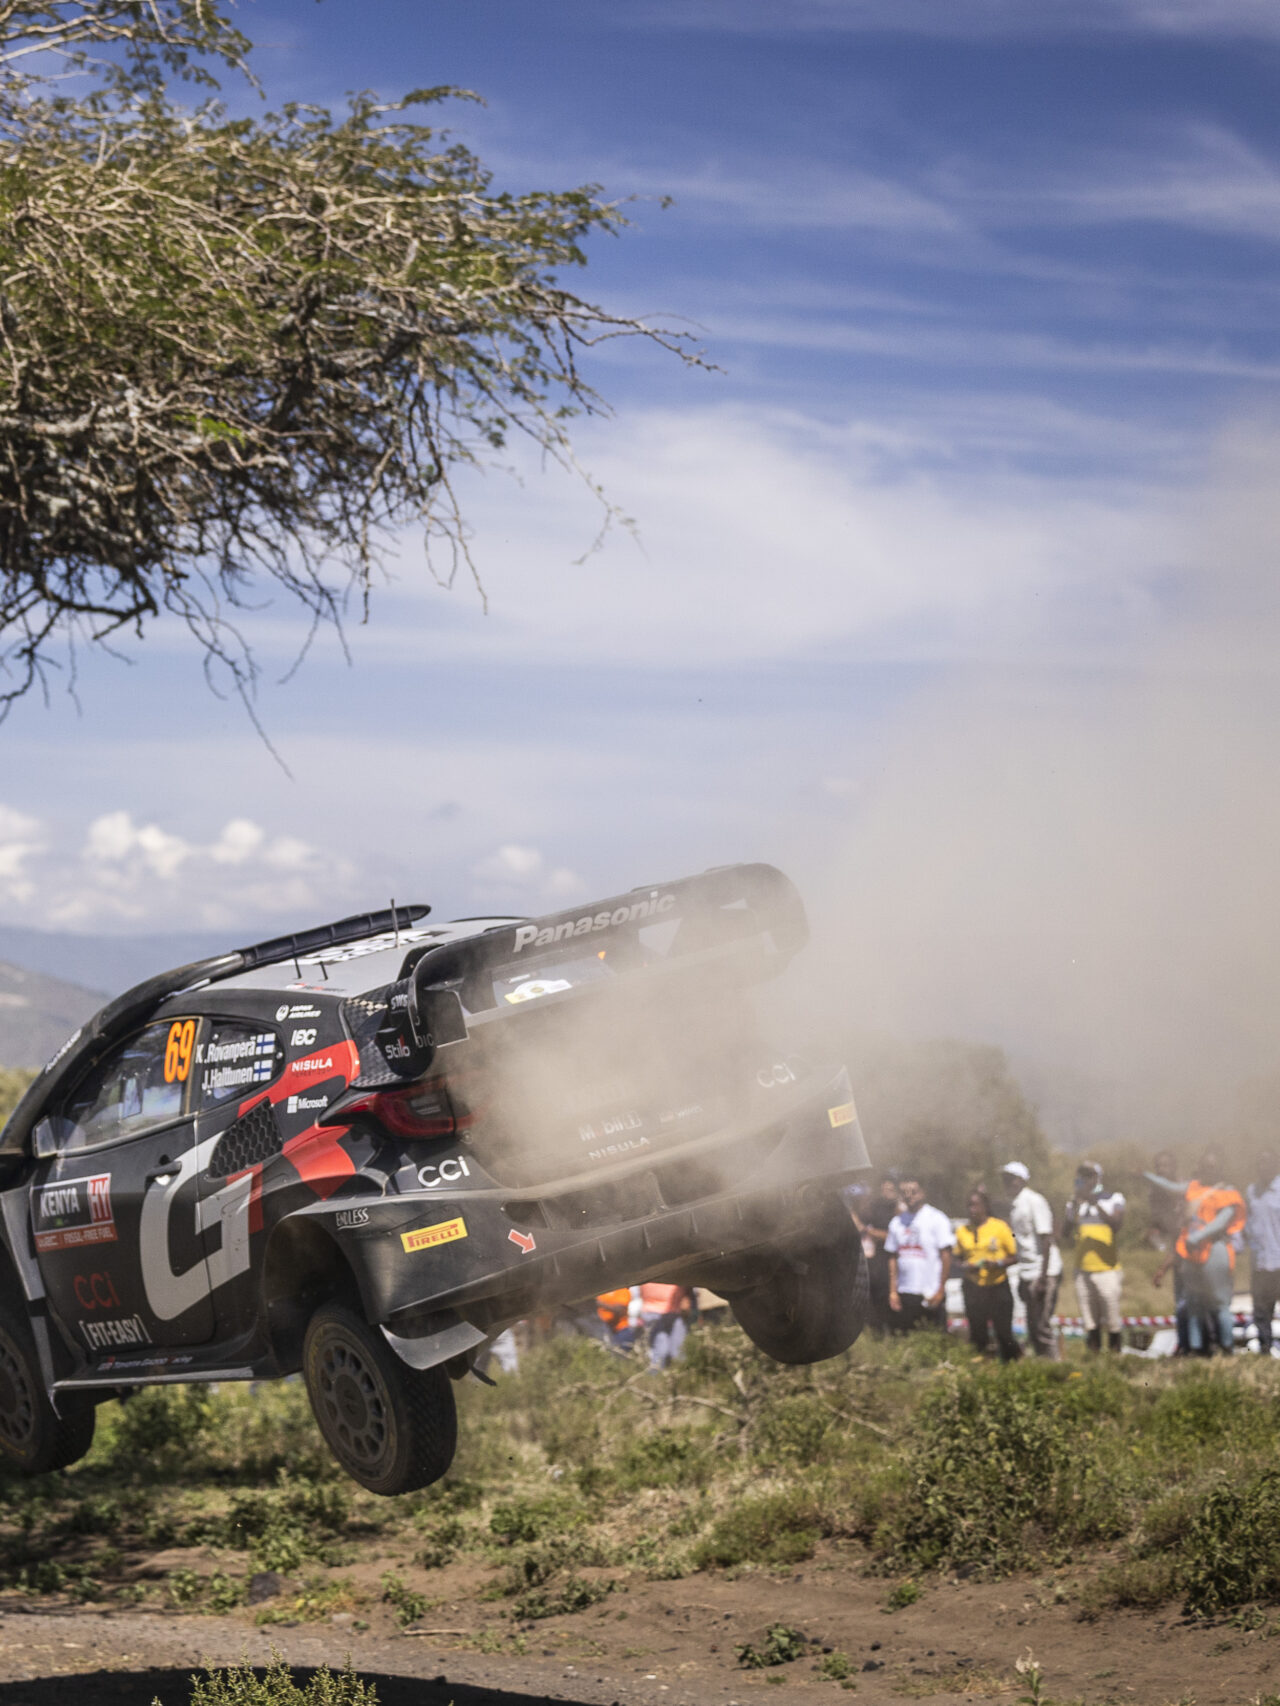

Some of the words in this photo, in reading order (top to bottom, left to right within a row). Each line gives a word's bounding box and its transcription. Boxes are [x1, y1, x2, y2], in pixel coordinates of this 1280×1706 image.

[513, 890, 677, 953] Panasonic
[165, 1019, 195, 1083] 69
[385, 1034, 411, 1060] Stilo
[291, 1057, 333, 1072] NISULA
[297, 1095, 329, 1110] Microsoft
[588, 1137, 650, 1159] NISULA
[40, 1187, 80, 1218] KENYA
[335, 1207, 369, 1227] ENDLESS
[406, 1223, 460, 1248] PIRELLI
